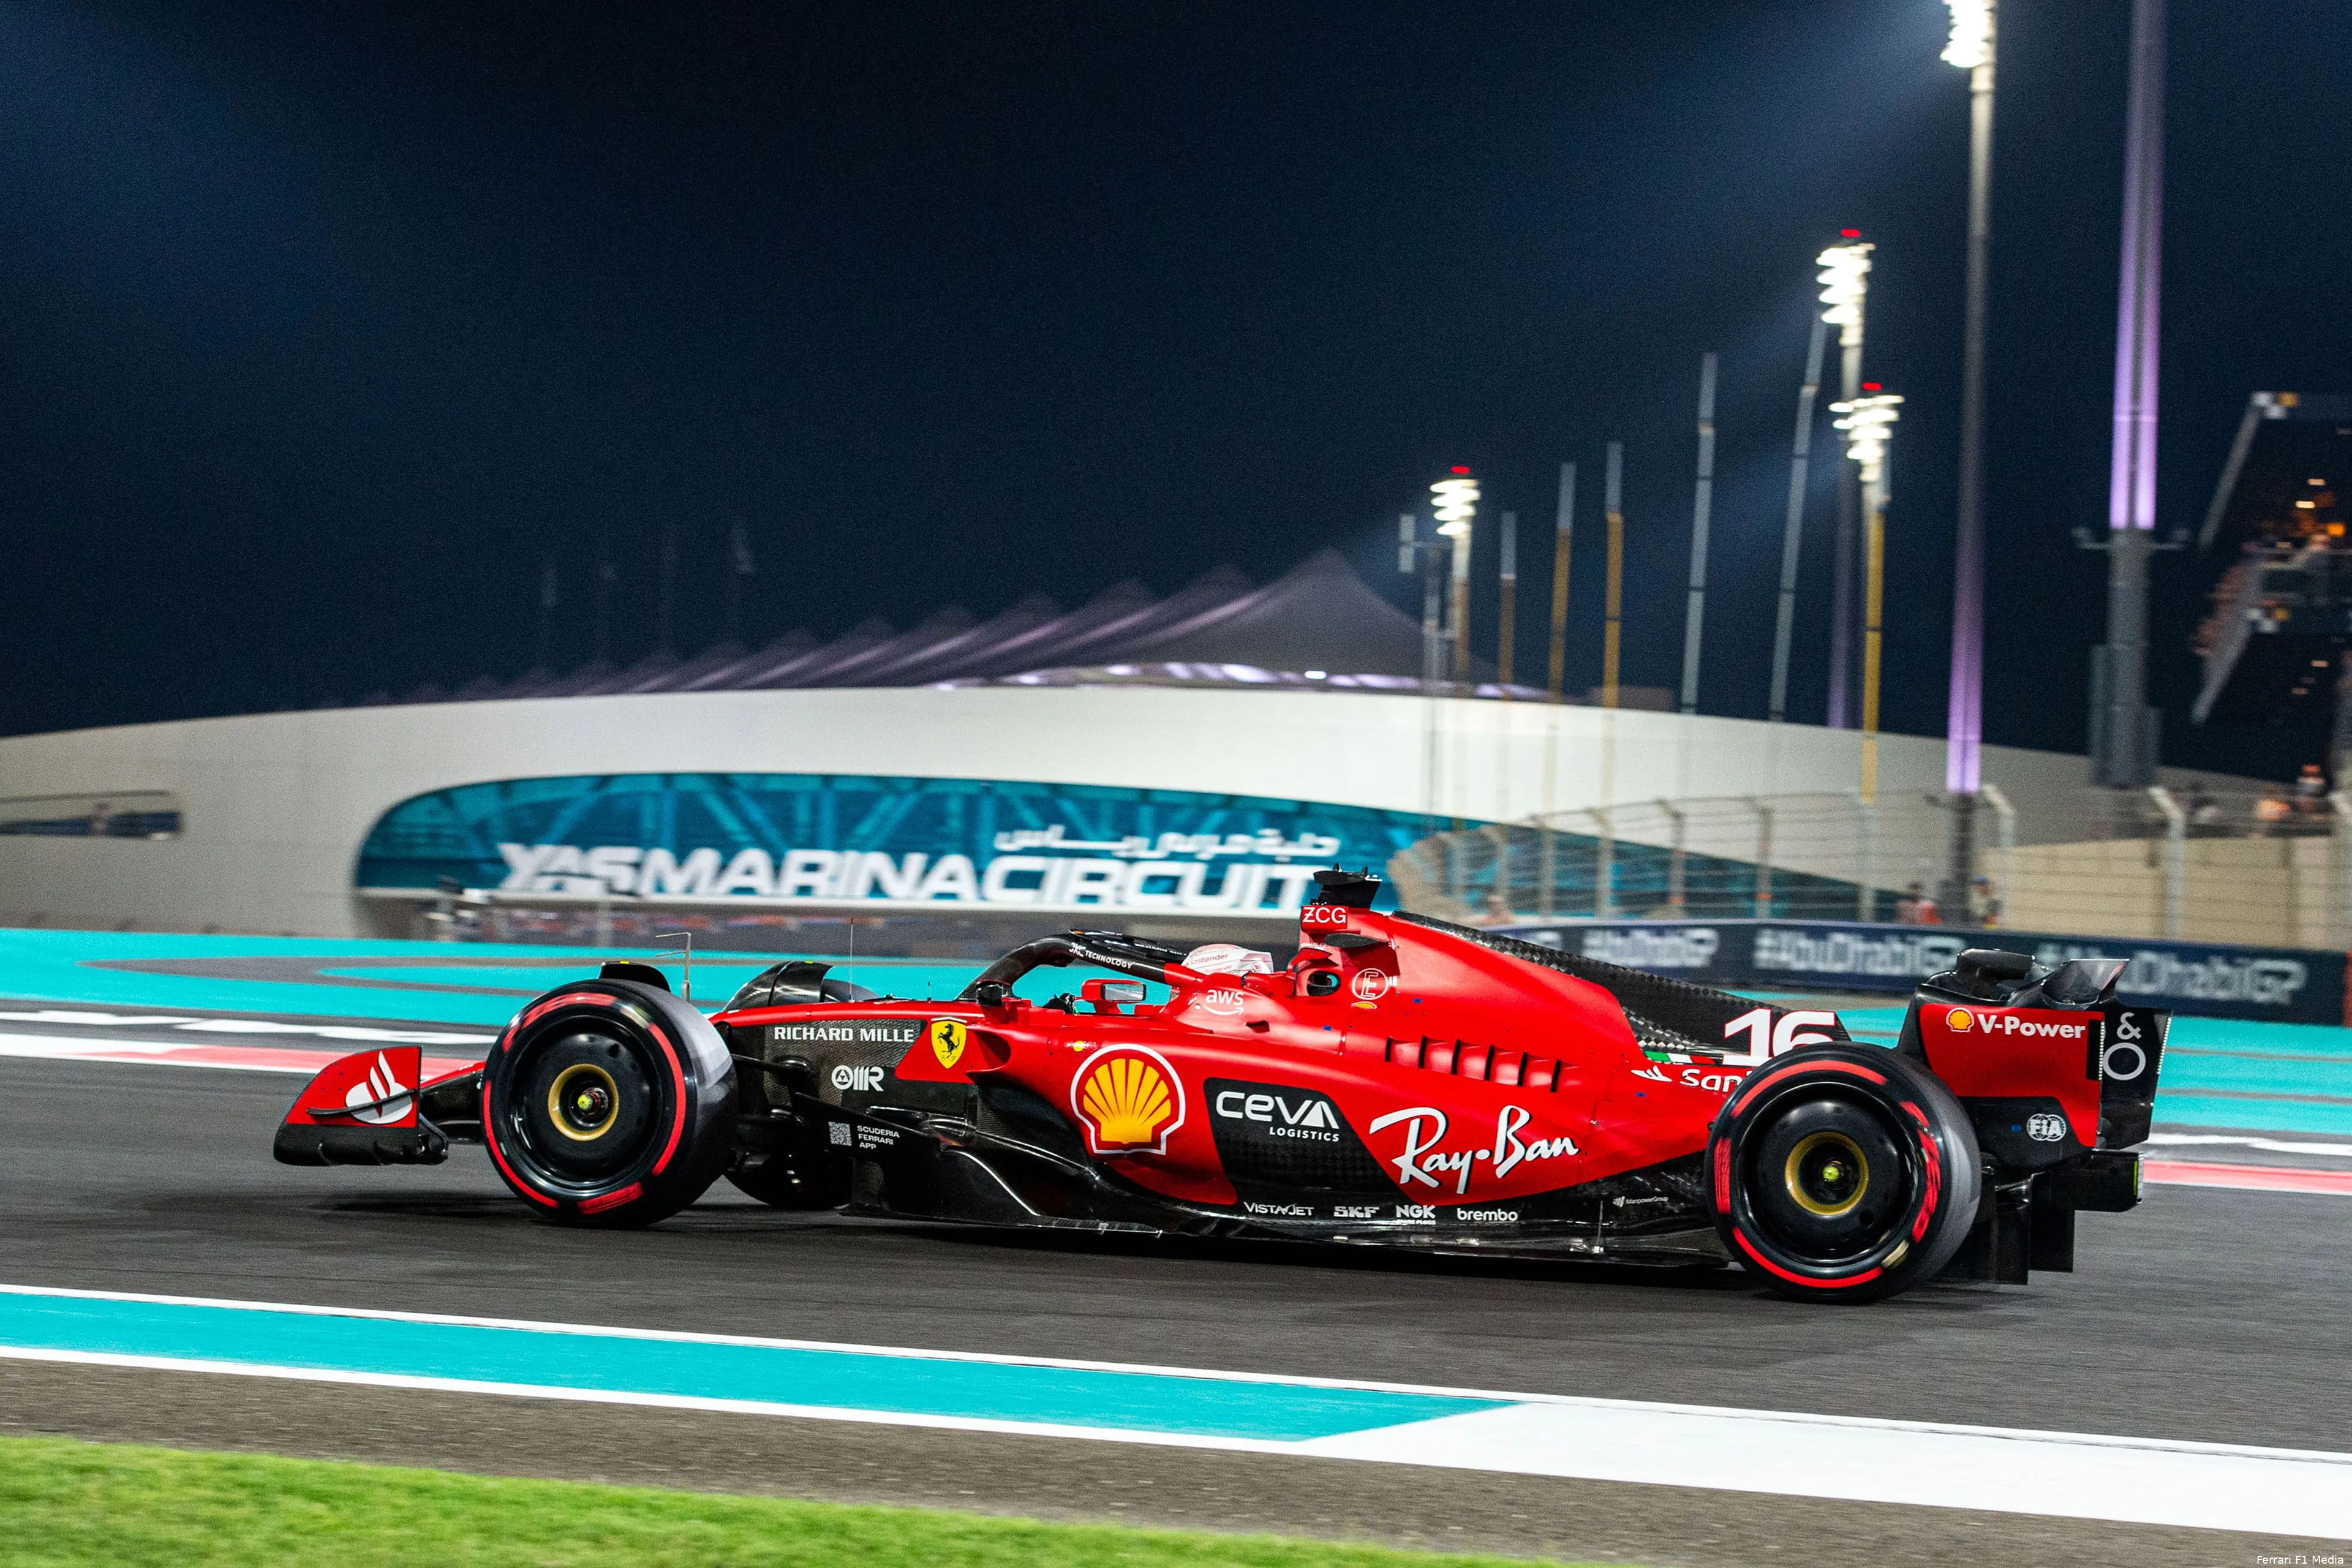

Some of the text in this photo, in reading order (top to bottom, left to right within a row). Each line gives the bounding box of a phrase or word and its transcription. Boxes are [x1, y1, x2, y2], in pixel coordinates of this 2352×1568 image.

[1085, 950, 1133, 969] TECHNOLOGY
[1205, 989, 1244, 1006] aws
[1978, 1014, 2086, 1039] V-Power
[774, 1027, 914, 1042] RICHARD MILLE
[1722, 1008, 1836, 1066] 16
[1679, 1068, 1753, 1093] San
[857, 1125, 900, 1138] SCUDERIA
[858, 1133, 894, 1145] FERRARI
[1269, 1126, 1340, 1142] LOGISTICS
[1333, 1205, 1379, 1218] SKF
[1395, 1204, 1436, 1219] NGK
[1457, 1208, 1518, 1222] brembo
